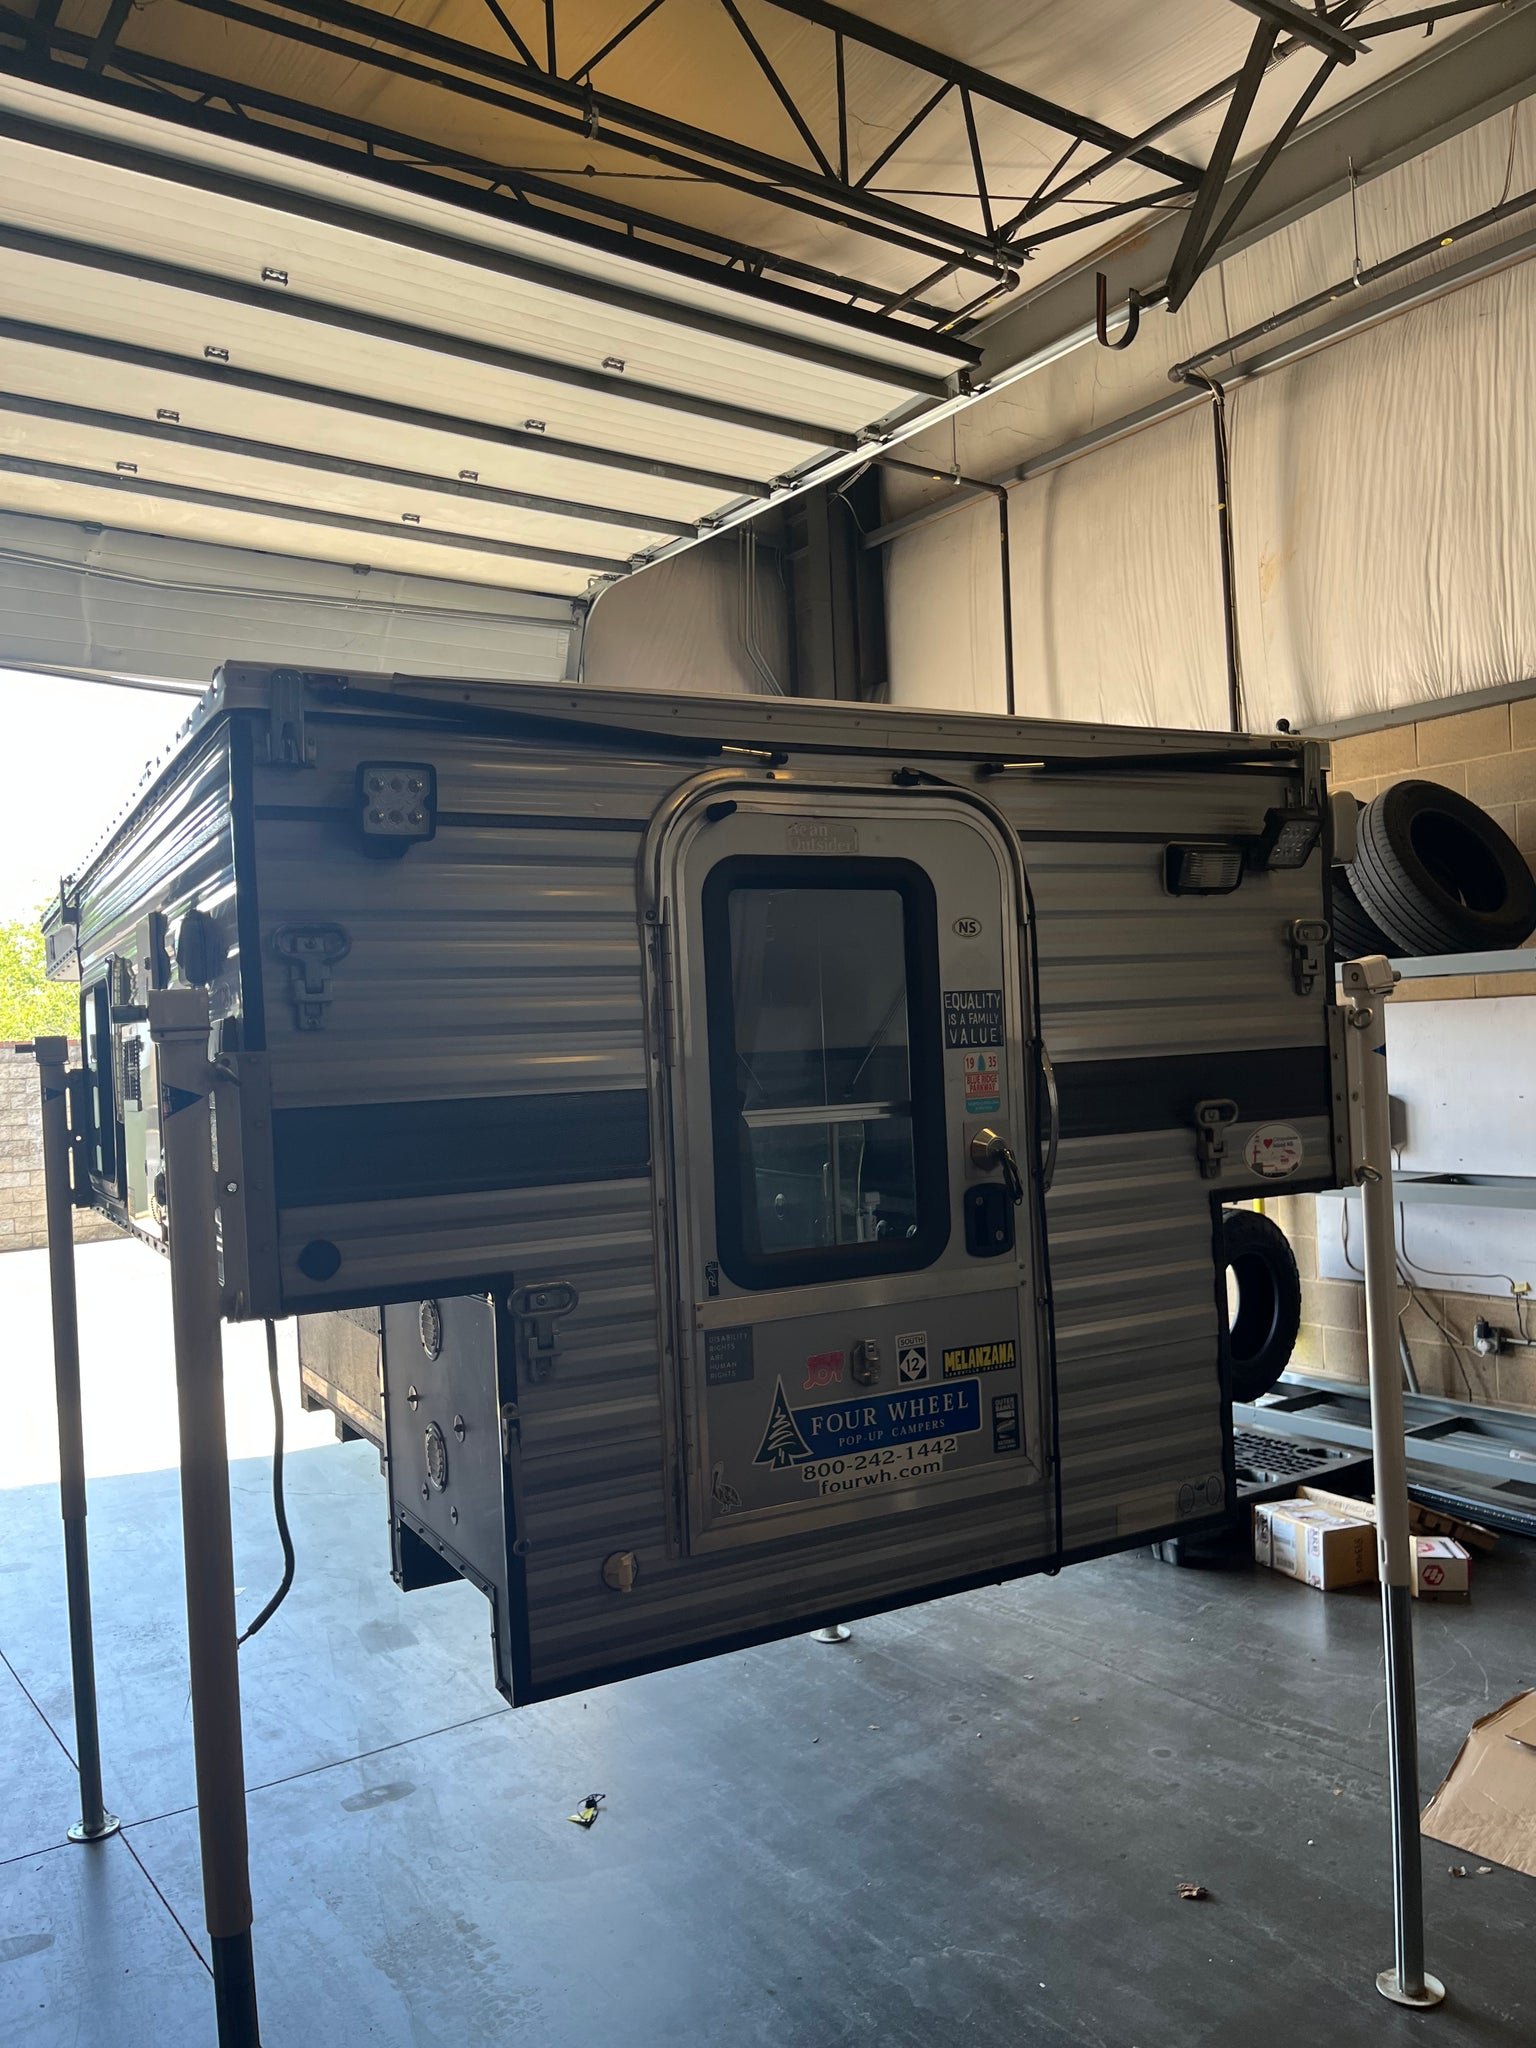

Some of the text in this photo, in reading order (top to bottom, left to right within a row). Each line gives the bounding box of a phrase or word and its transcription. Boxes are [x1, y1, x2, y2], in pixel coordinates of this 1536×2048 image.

[959, 921, 976, 933] NS
[944, 992, 1000, 1010] EQUALITY
[948, 1012, 999, 1025] IS A FAMILY
[950, 1028, 998, 1044] VALUE
[966, 1055, 997, 1069] 19 35
[900, 1336, 923, 1346] SOUTH
[906, 1357, 920, 1372] 12
[944, 1342, 1015, 1373] MELANZANA
[810, 1390, 969, 1436] FOUR WHEEL
[839, 1419, 945, 1448] POP-UP CAMPERS
[803, 1437, 956, 1481] 800-242-1442
[821, 1460, 941, 1495] fourwh.com
